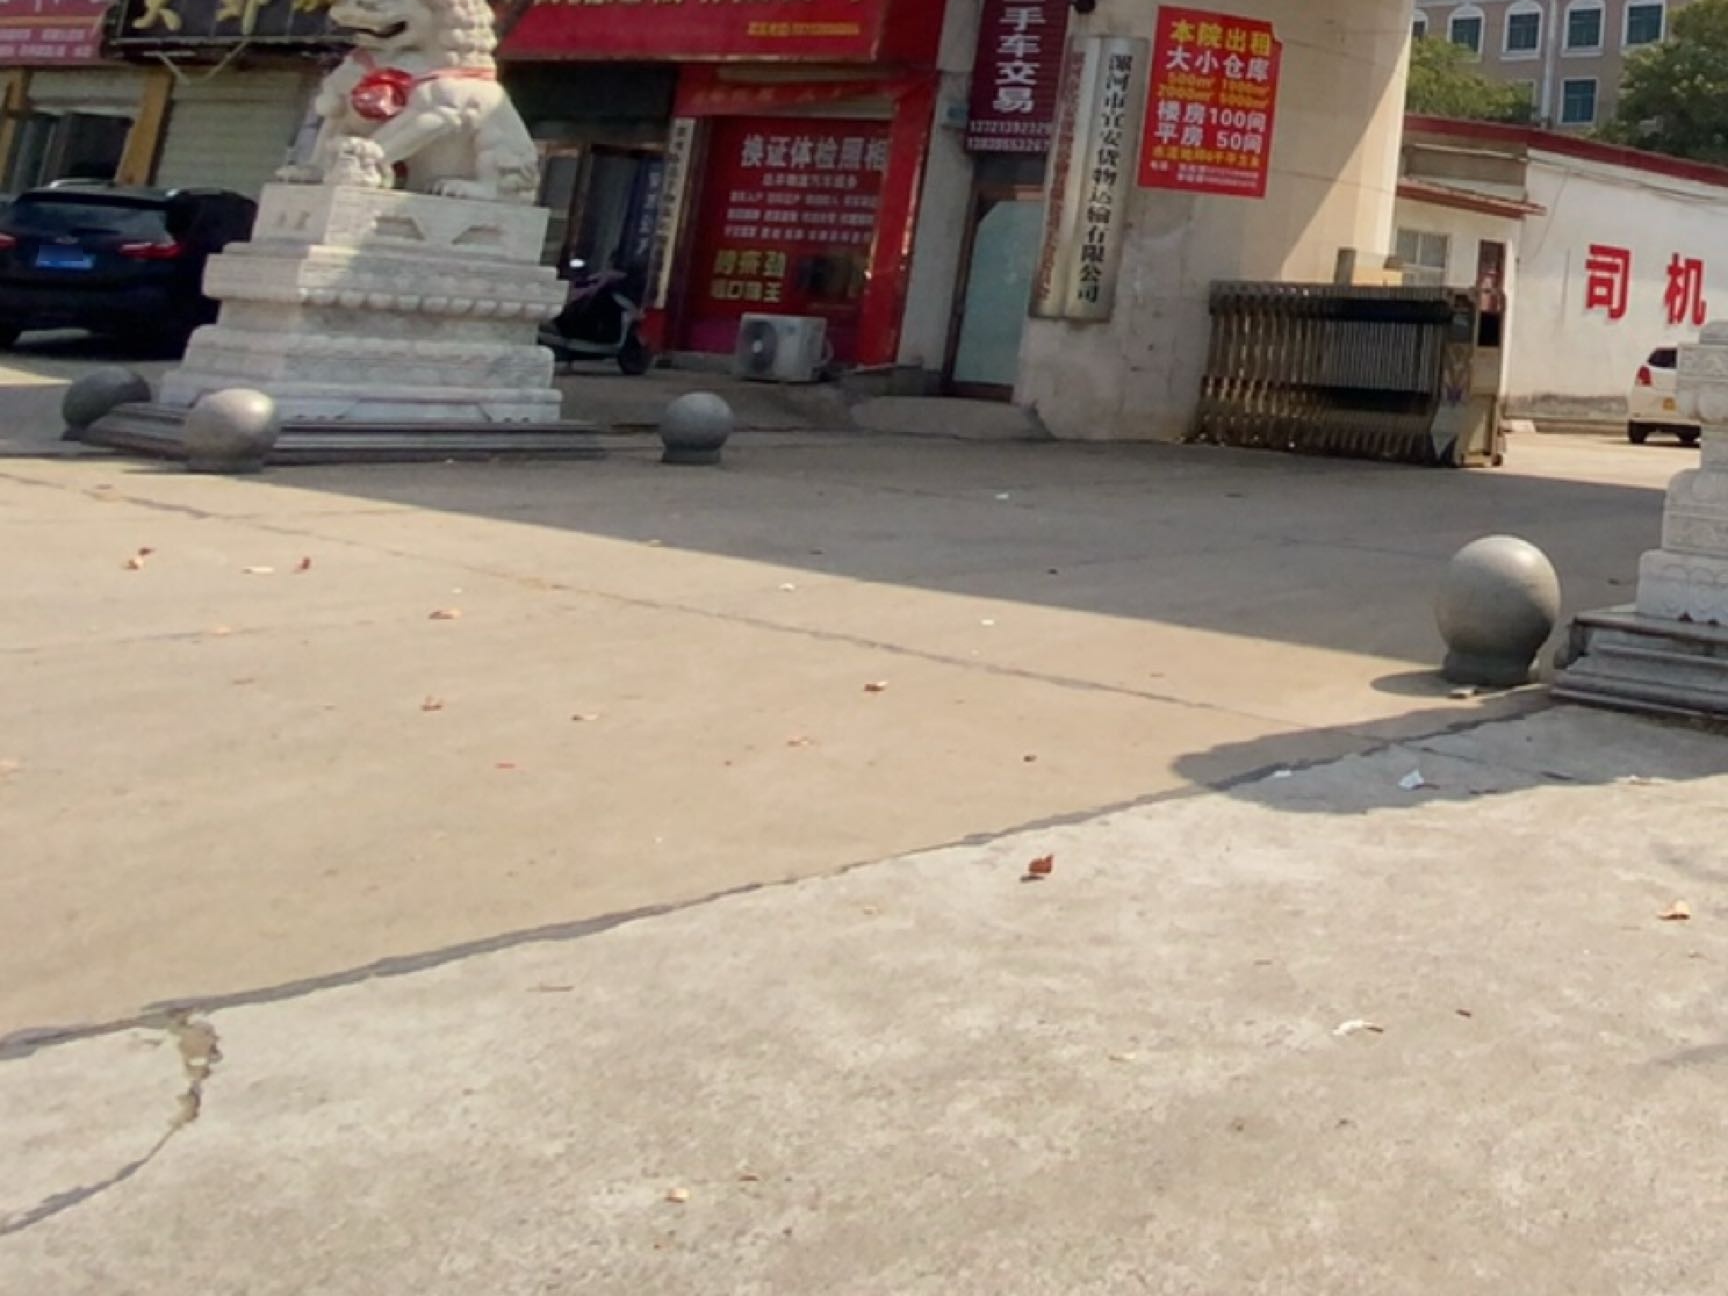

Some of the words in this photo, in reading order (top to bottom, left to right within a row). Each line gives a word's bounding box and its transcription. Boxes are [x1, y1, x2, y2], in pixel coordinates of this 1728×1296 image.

[1166, 45, 1269, 82] 大小仓库
[1585, 244, 1706, 325] 司机
